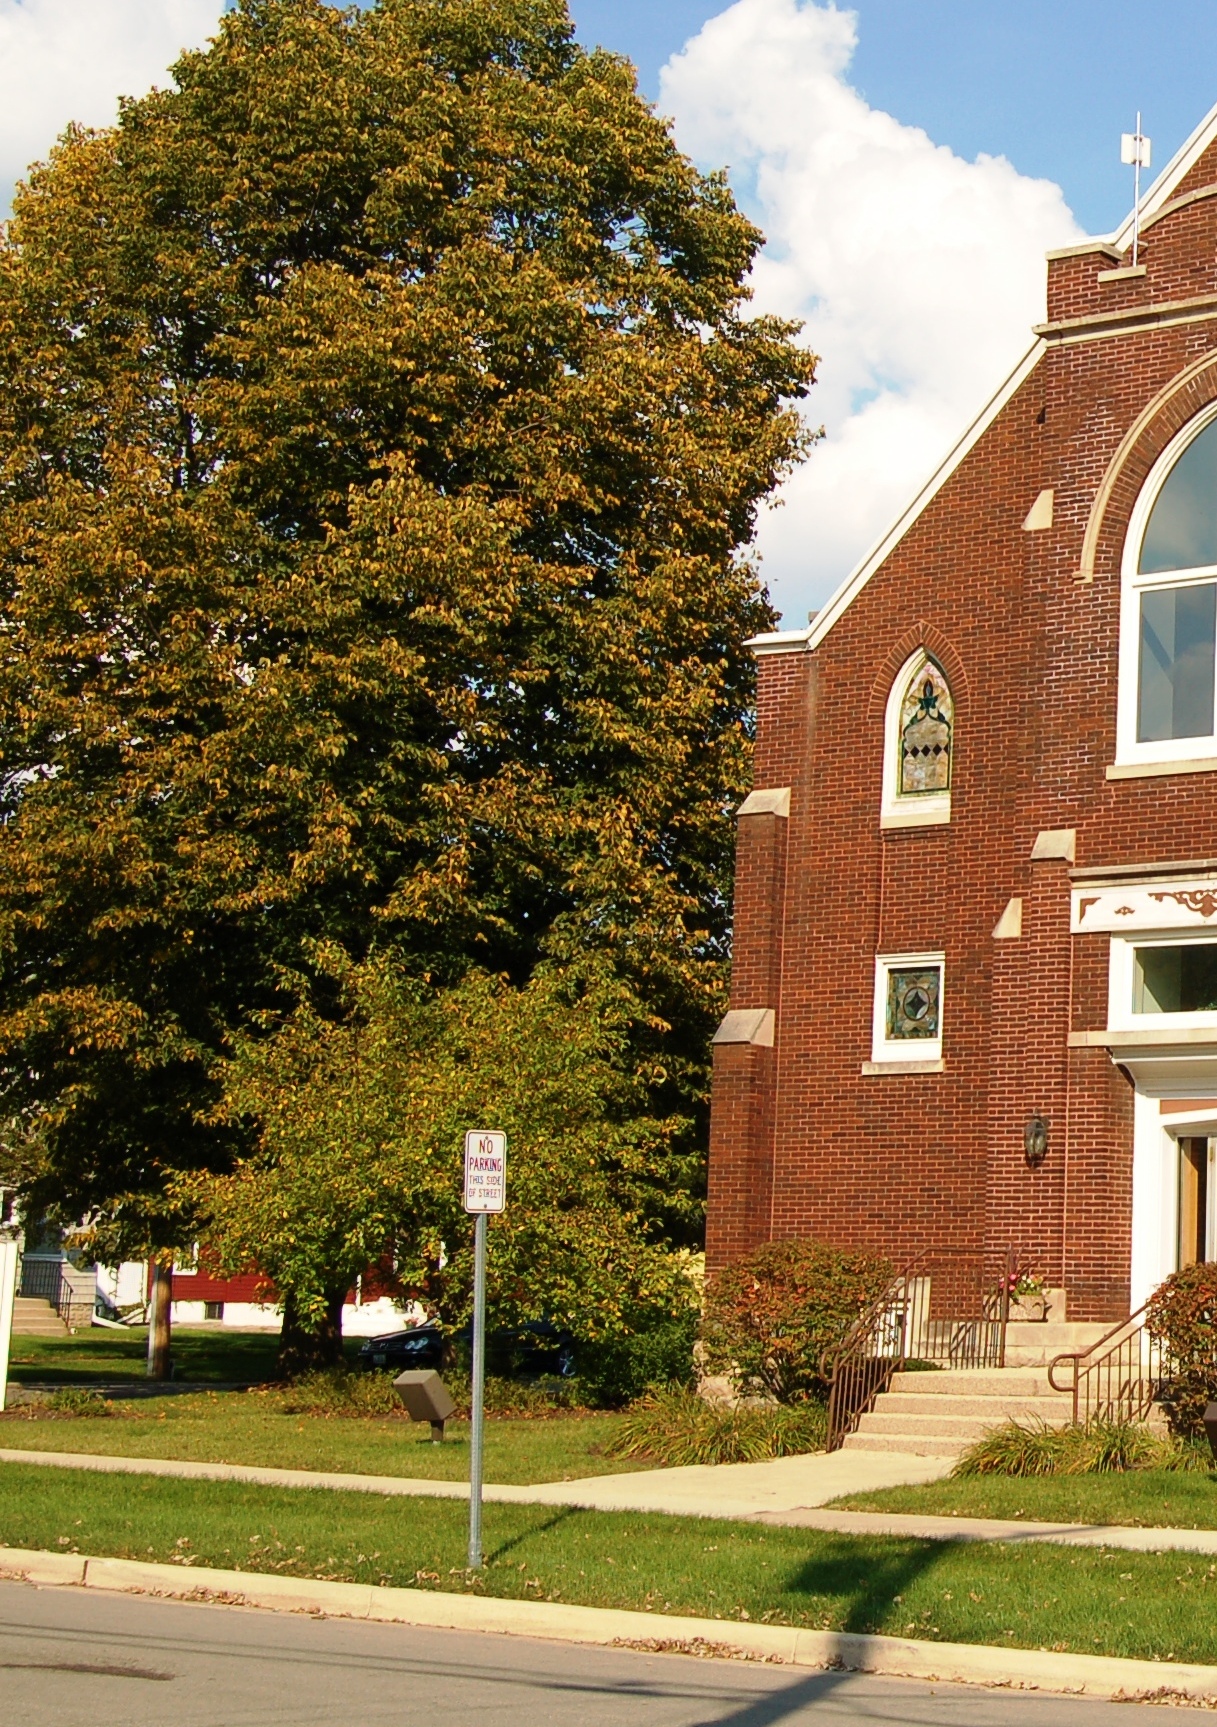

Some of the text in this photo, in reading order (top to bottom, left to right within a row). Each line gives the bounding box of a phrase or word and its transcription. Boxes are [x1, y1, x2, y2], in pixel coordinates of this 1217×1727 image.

[479, 1139, 493, 1154] NO
[469, 1157, 502, 1172] PARKING
[469, 1175, 502, 1186] THIS SIDE
[468, 1188, 501, 1199] OF STREET
